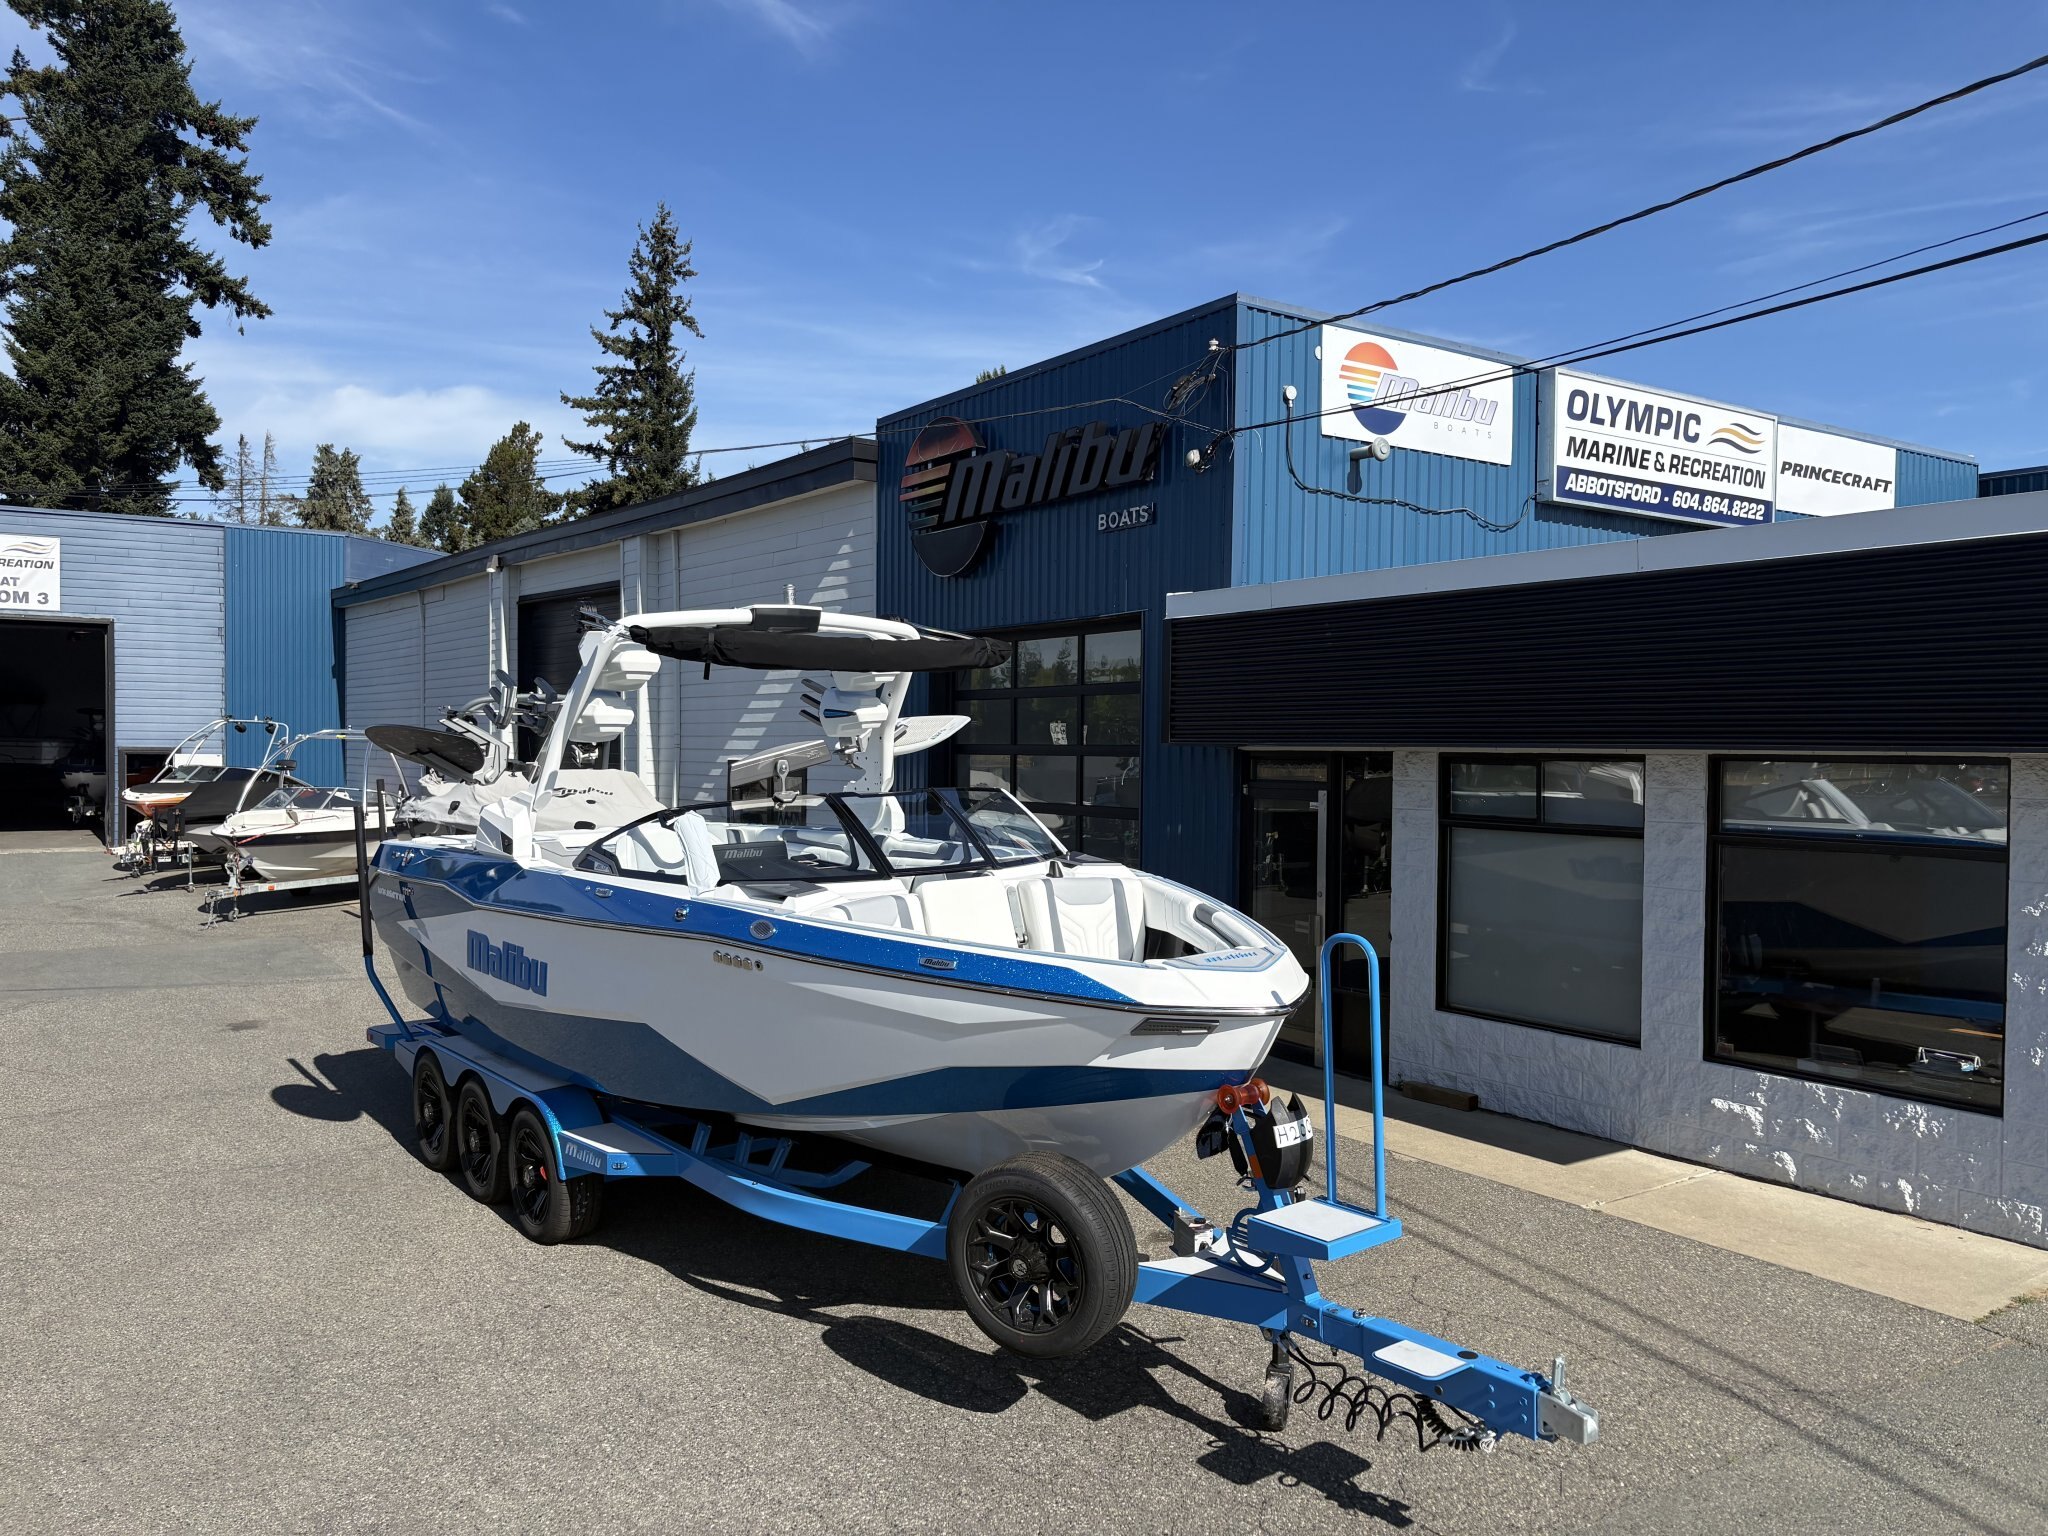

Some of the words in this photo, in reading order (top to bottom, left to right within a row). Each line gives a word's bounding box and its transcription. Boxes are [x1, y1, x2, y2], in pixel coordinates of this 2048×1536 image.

[1433, 421, 1492, 440] BOATS
[1566, 388, 1702, 444] OLYMPIC
[1565, 435, 1652, 471] MARINE
[1654, 451, 1666, 473] &
[1669, 453, 1767, 490] RECREATION
[1780, 460, 1893, 493] PRINCECRAFT
[1565, 472, 1662, 505] ABBOTSFORD
[1672, 489, 1766, 521] 604.864.8222
[1098, 504, 1149, 531] BOATS
[36, 591, 50, 605] 3
[466, 928, 548, 998] Malibu
[565, 1141, 602, 1169] Malibu
